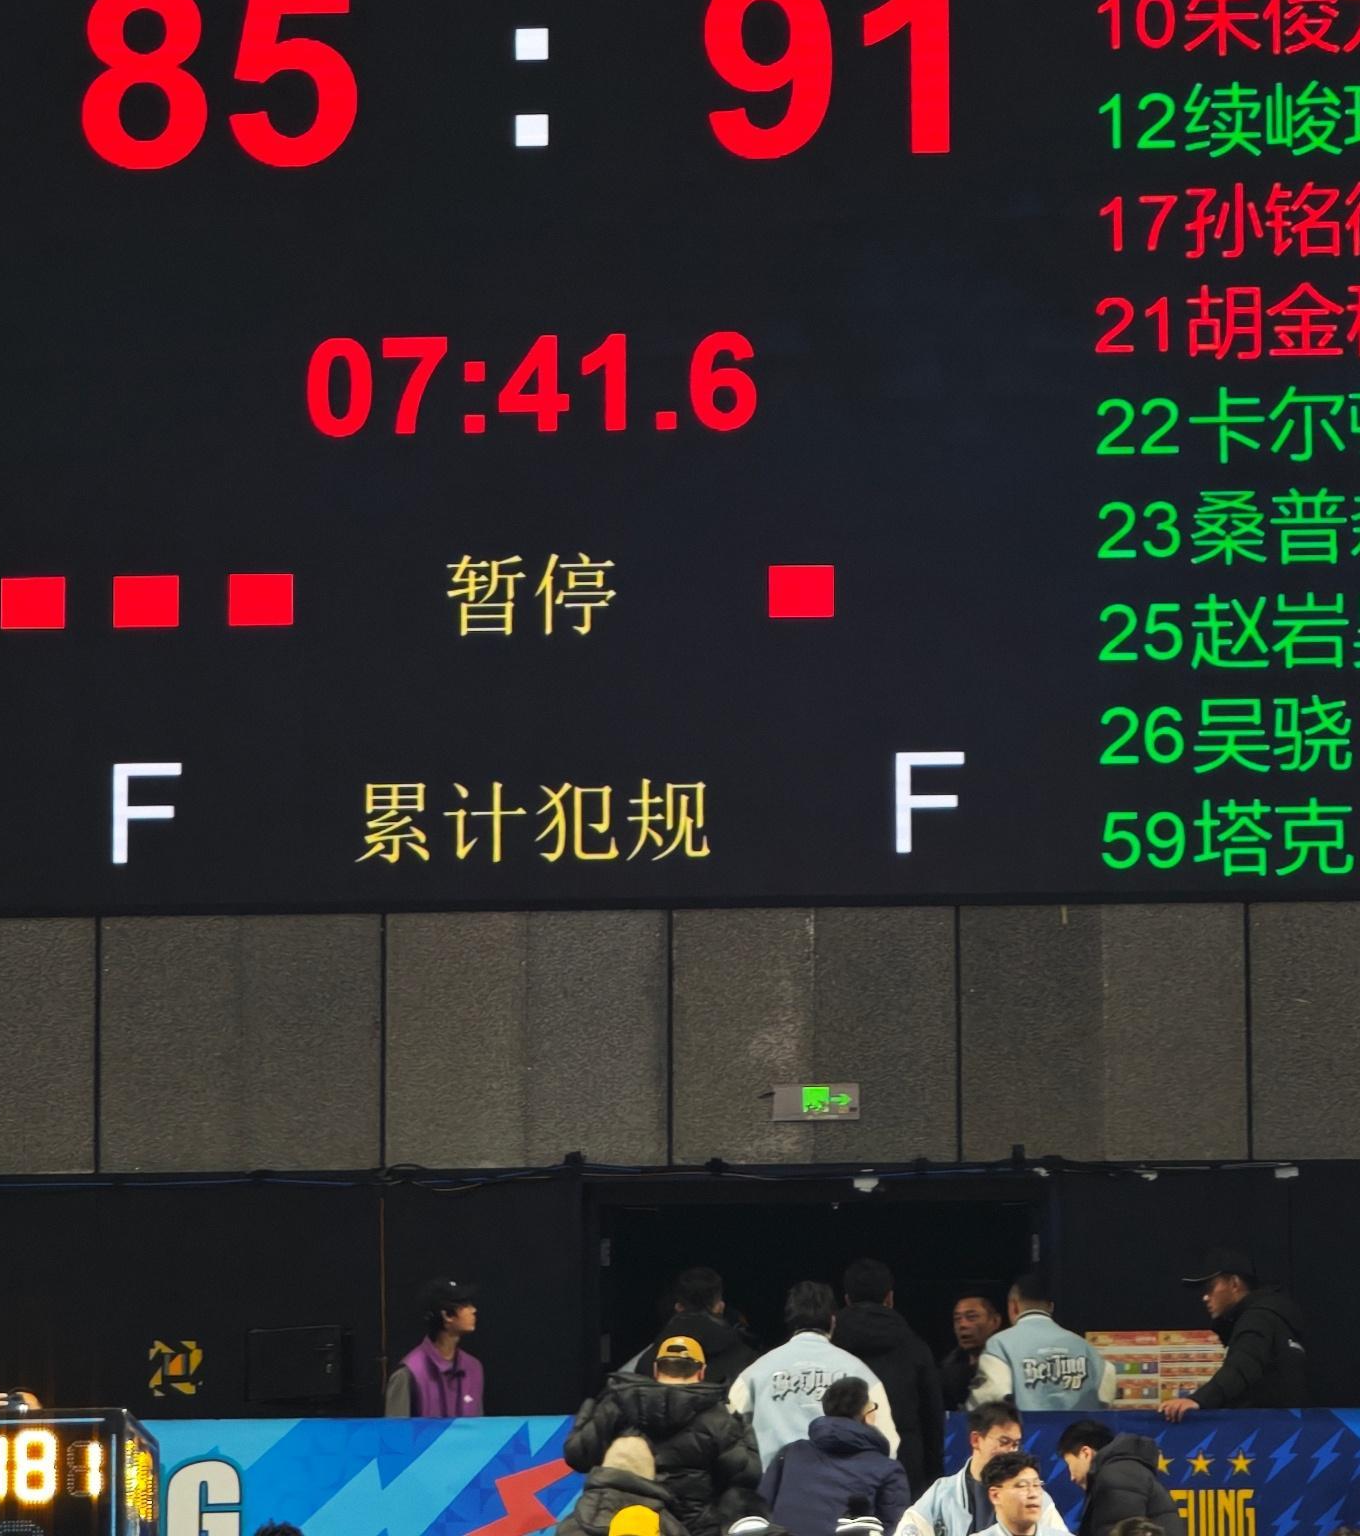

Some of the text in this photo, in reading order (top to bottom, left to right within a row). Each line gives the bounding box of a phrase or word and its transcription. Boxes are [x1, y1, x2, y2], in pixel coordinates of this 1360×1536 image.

[306, 330, 758, 439] 07:41.6
[446, 552, 617, 637] 暂停
[112, 751, 966, 865] F 累计犯规 F
